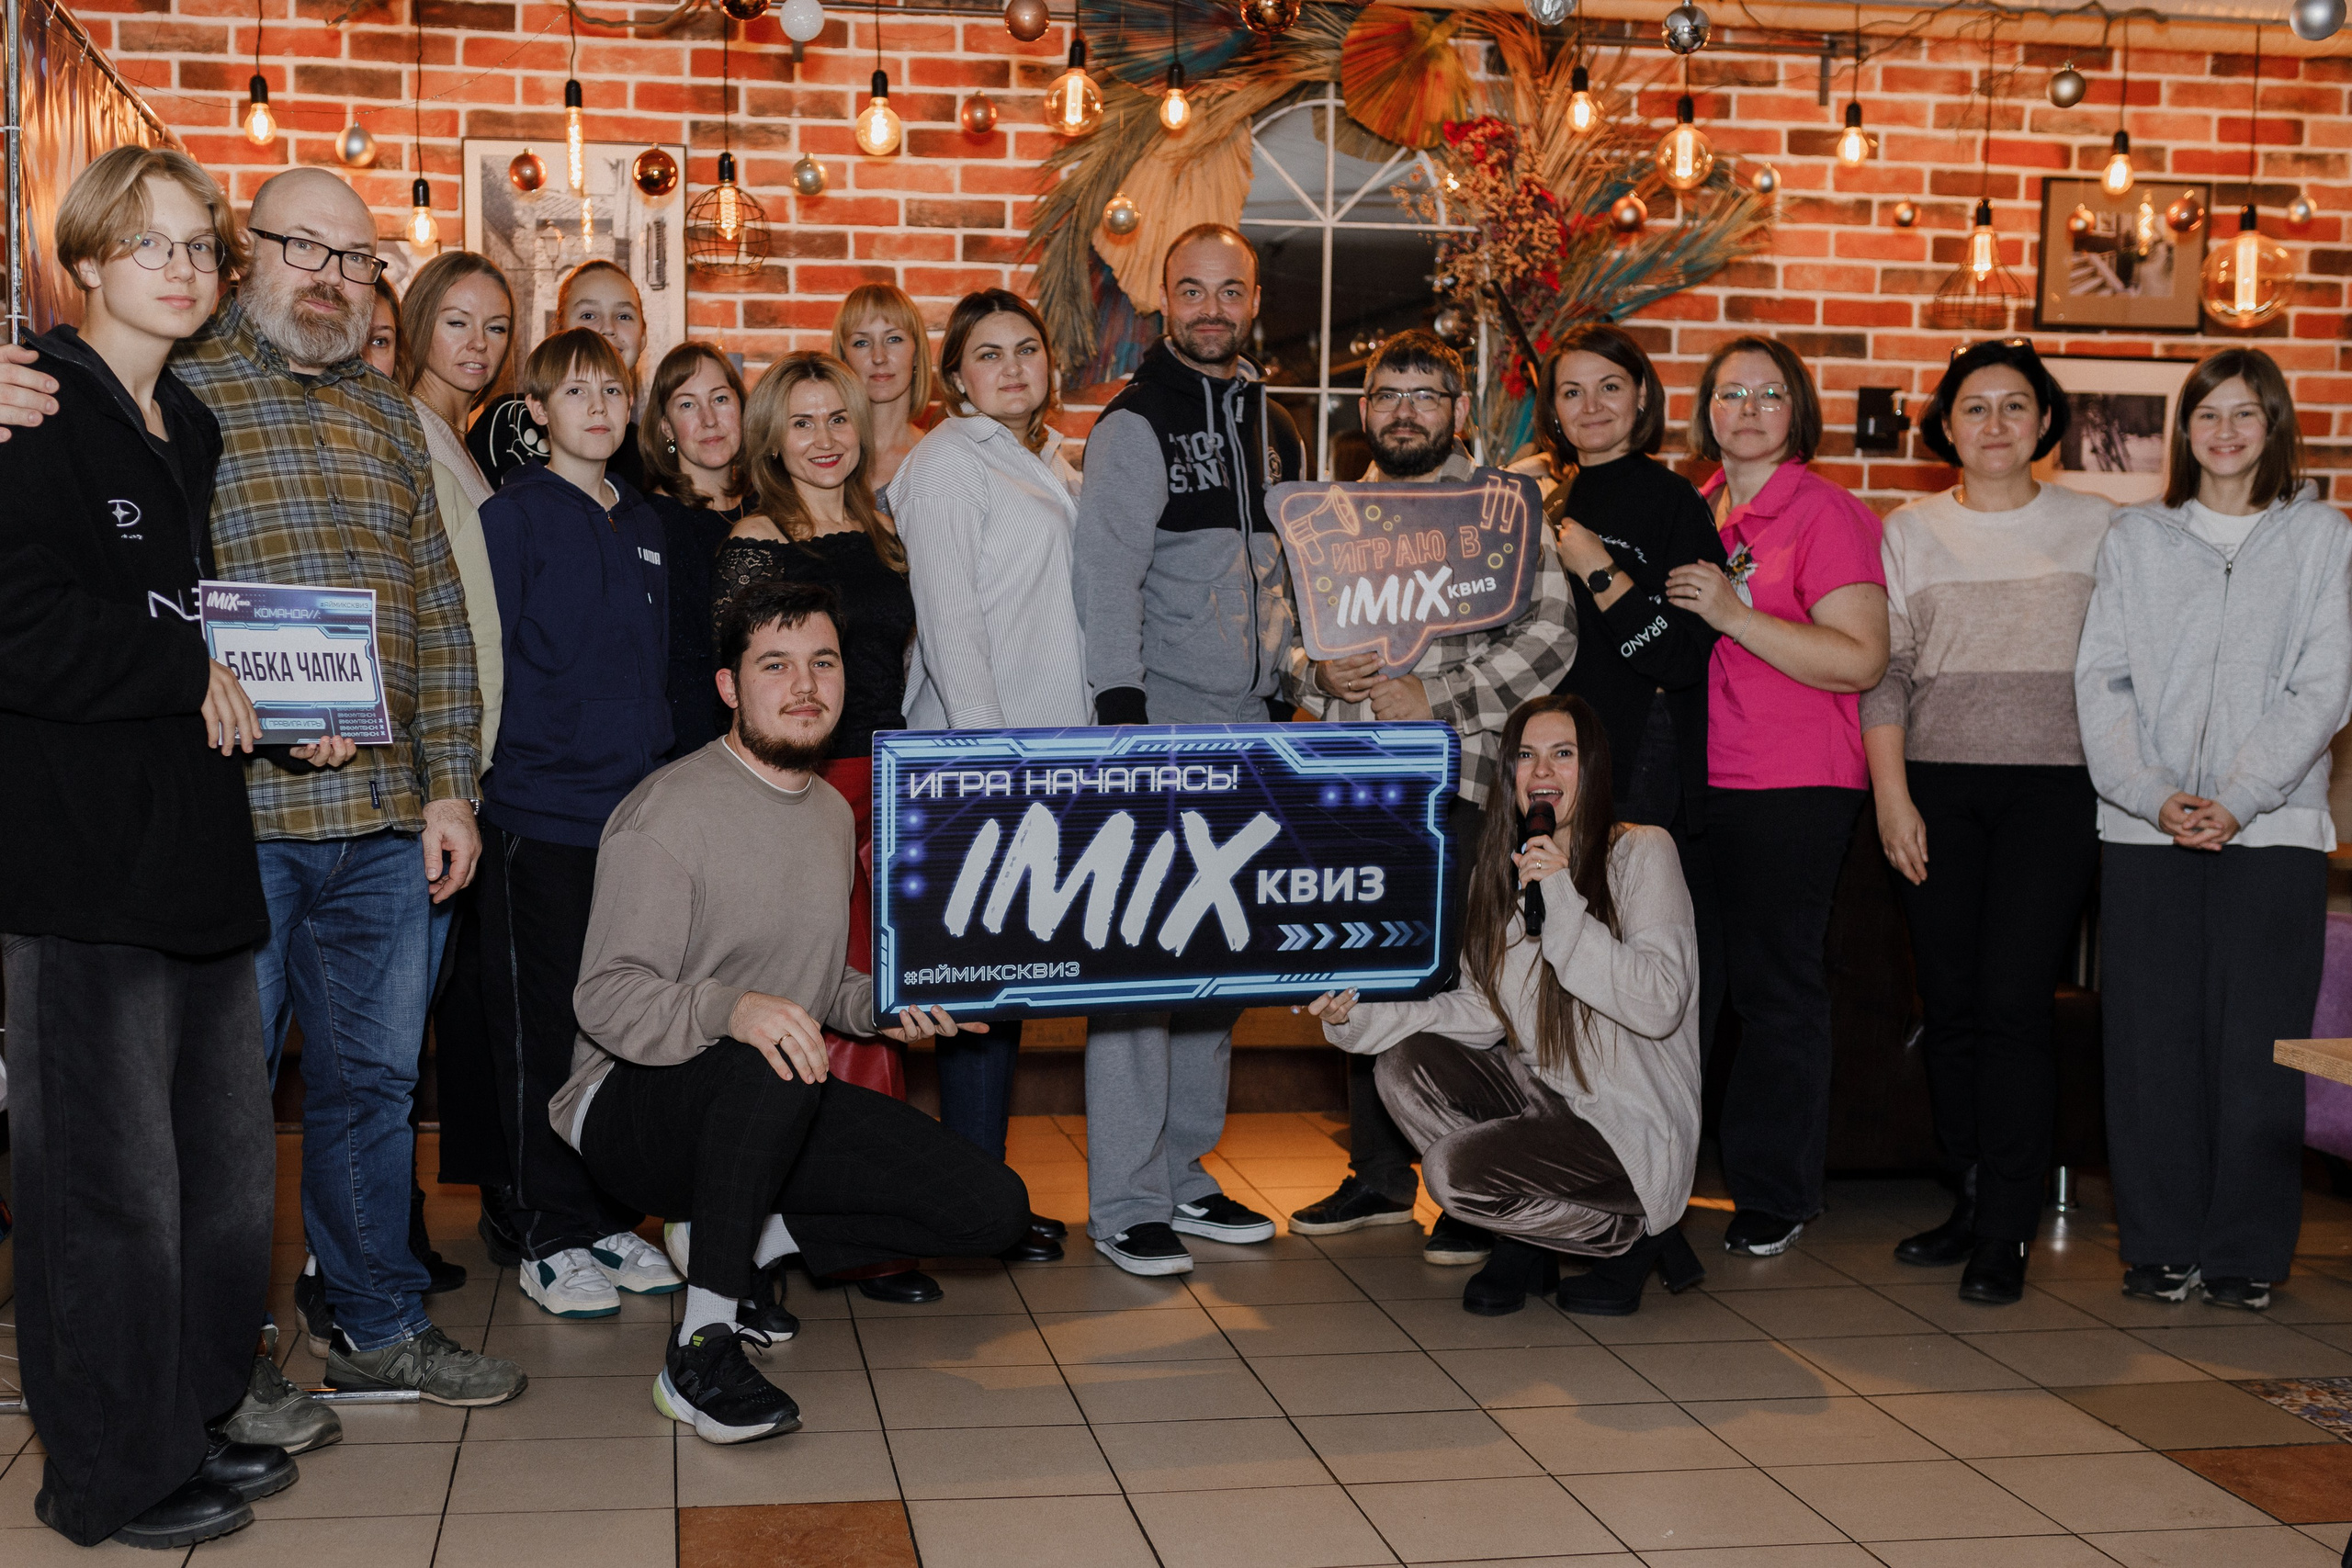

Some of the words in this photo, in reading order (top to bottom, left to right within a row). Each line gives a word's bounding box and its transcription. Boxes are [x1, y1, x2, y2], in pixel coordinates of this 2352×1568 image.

[1331, 529, 1447, 575] ИГРАЮ
[1459, 525, 1482, 559] В
[206, 591, 241, 611] IMIX
[1336, 565, 1453, 629] IMIX
[1620, 615, 1668, 659] BRAND
[224, 650, 294, 682] БАБКА
[296, 651, 363, 682] ЧАПКА
[909, 766, 1012, 799] ИГРА
[1025, 763, 1240, 797] НАЧАЛАСЬ!
[944, 802, 1283, 958] IMIX
[1256, 865, 1386, 906] КВИЗ
[903, 962, 1080, 986] #АЙМИКСКВИЗ
